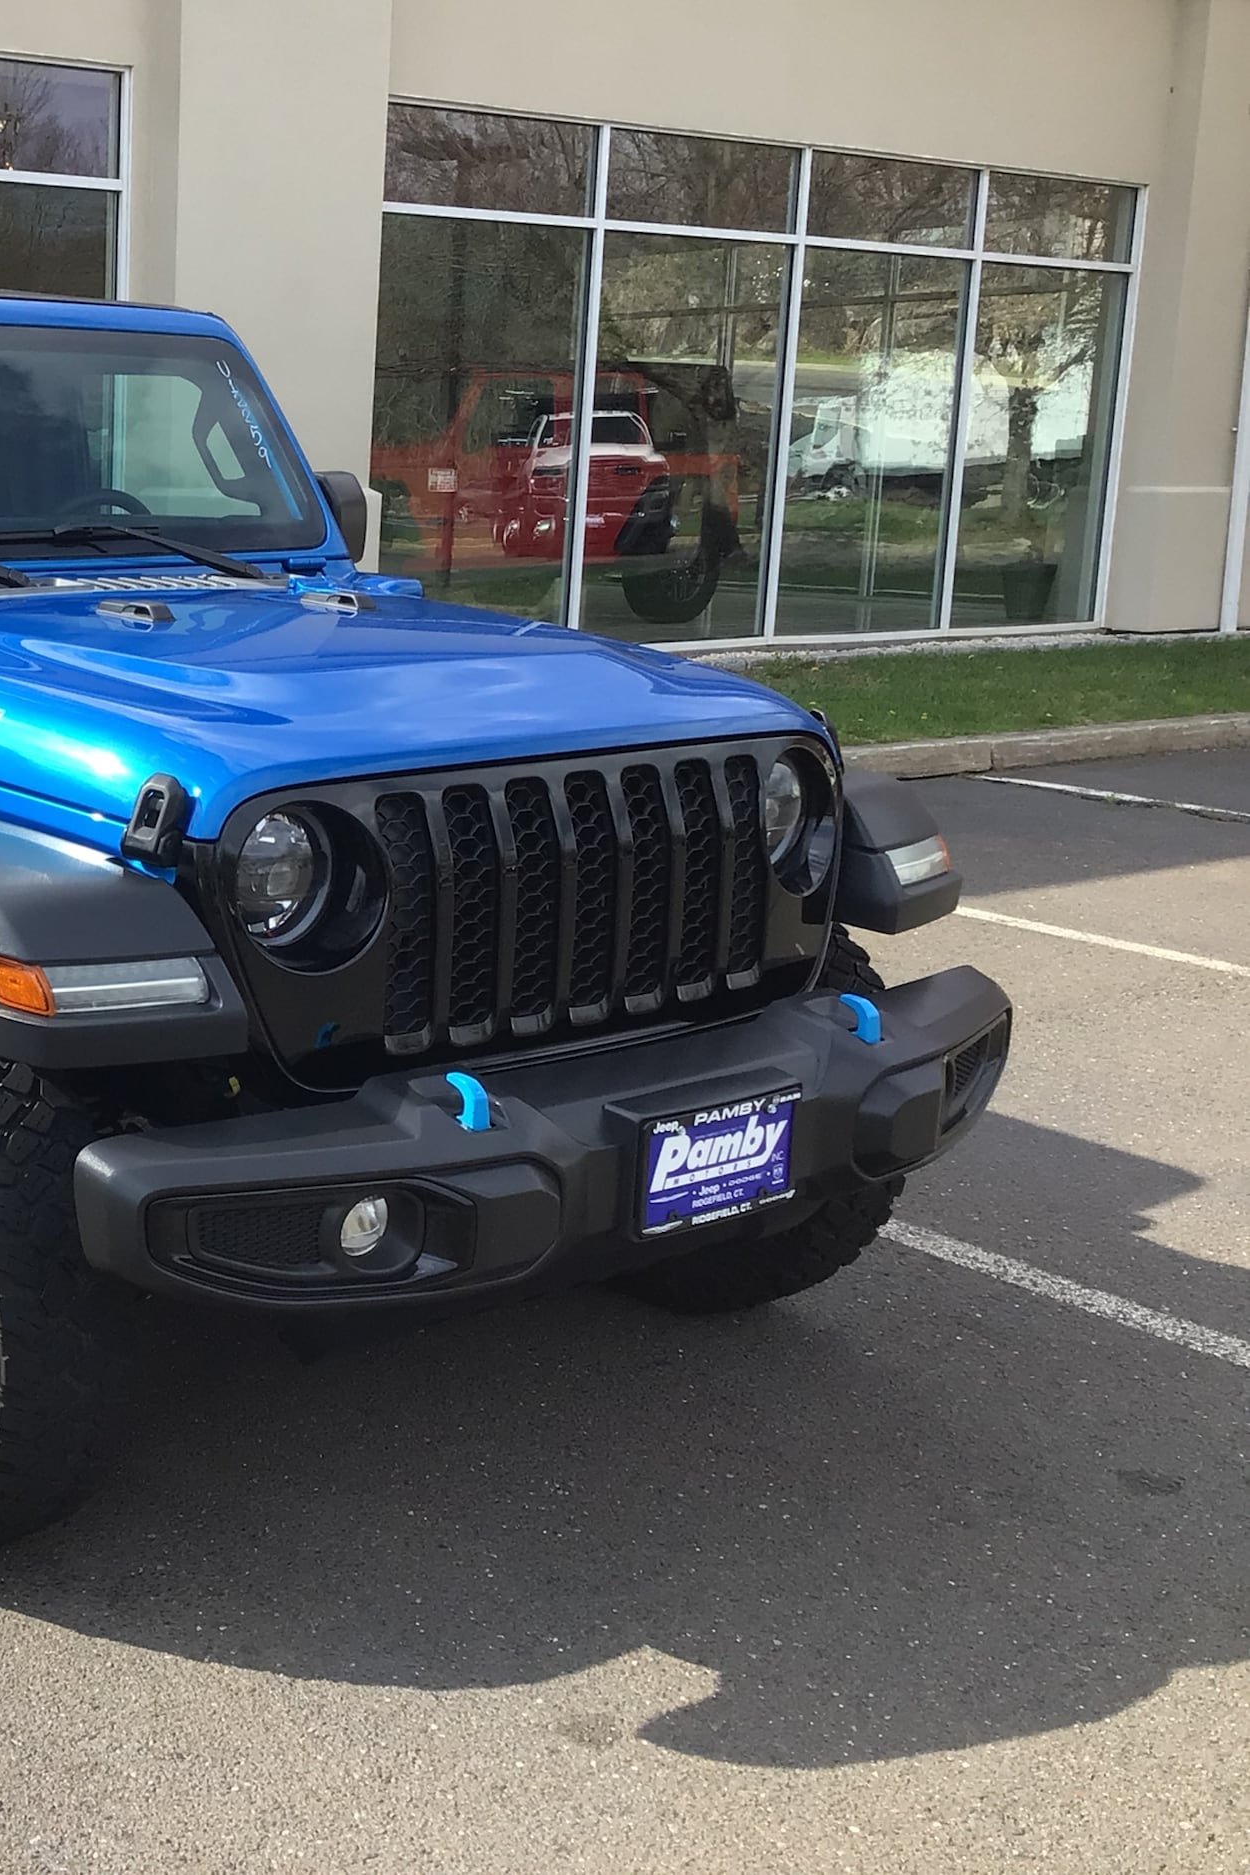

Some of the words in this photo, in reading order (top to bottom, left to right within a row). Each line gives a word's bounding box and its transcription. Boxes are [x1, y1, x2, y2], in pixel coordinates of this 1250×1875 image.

[693, 1098, 767, 1127] PAMBY
[652, 1120, 680, 1135] Jeep
[649, 1114, 789, 1194] Pamby
[697, 1182, 720, 1197] Jeep
